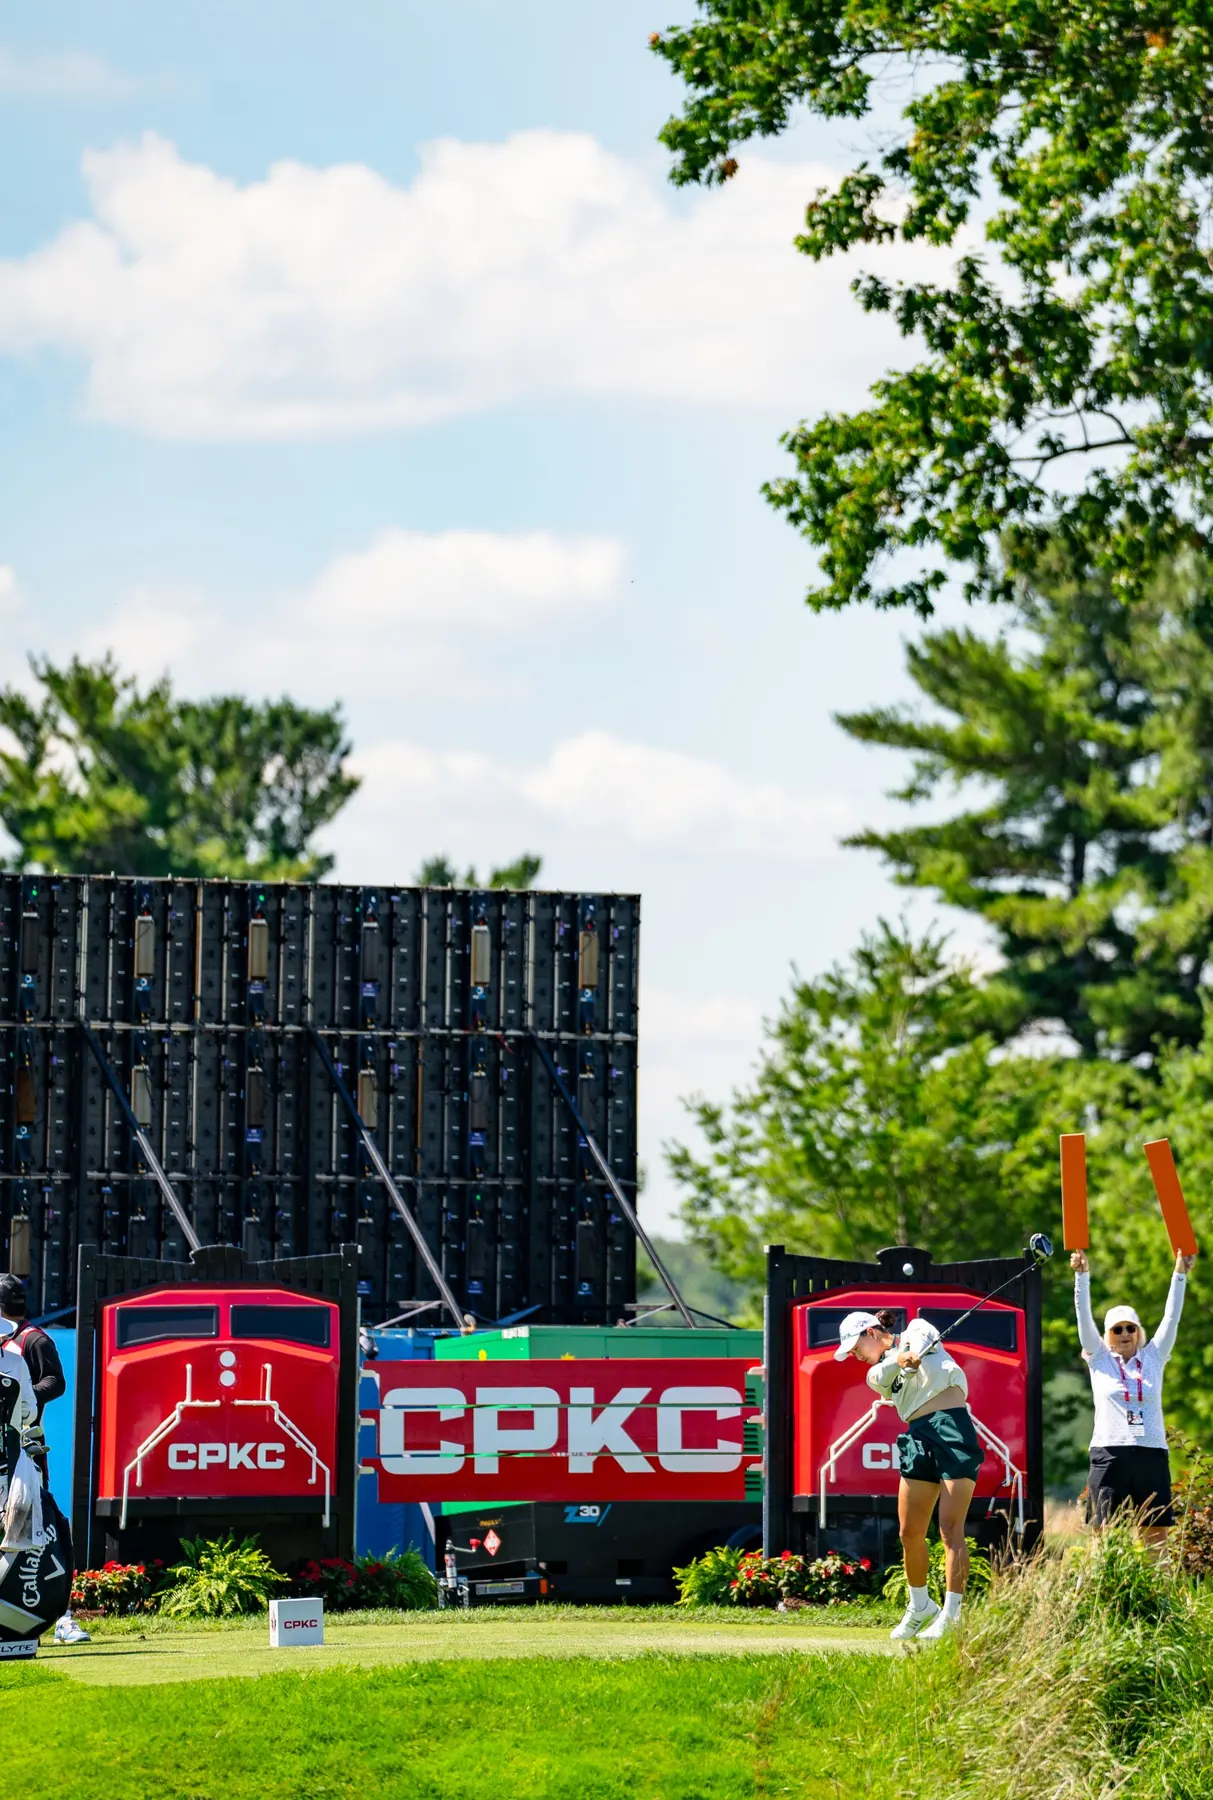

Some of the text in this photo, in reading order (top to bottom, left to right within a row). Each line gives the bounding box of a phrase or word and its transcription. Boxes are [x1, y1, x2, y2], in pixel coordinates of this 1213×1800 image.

[380, 1386, 743, 1474] CPKC
[168, 1442, 286, 1470] CPKC
[283, 1619, 318, 1629] CPKC
[0, 1644, 33, 1653] LYTE
